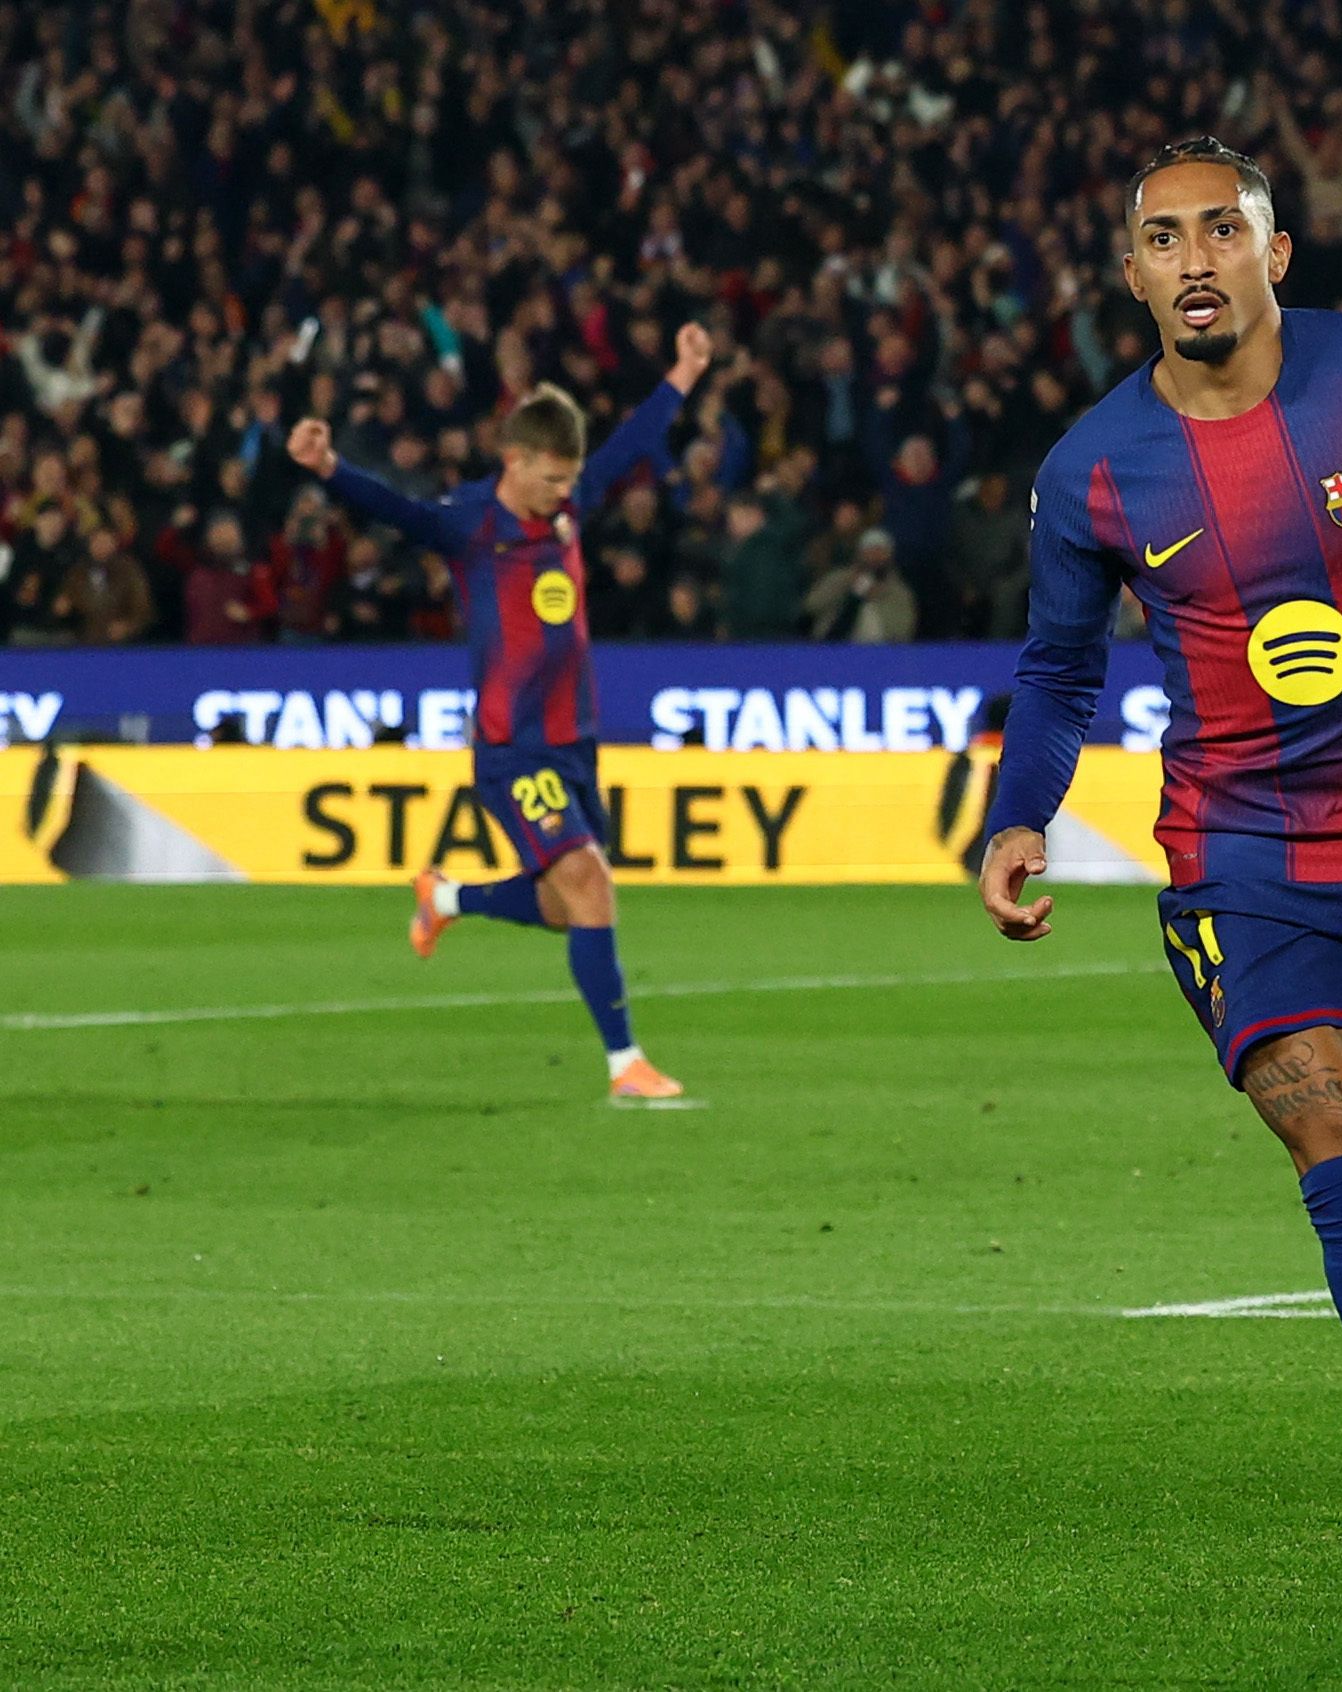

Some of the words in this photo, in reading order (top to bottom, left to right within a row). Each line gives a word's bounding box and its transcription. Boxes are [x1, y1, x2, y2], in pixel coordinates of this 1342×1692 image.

[193, 688, 477, 751] STANLE
[651, 686, 981, 752] STANLEY
[303, 783, 809, 870] STALEY
[511, 767, 570, 822] 20
